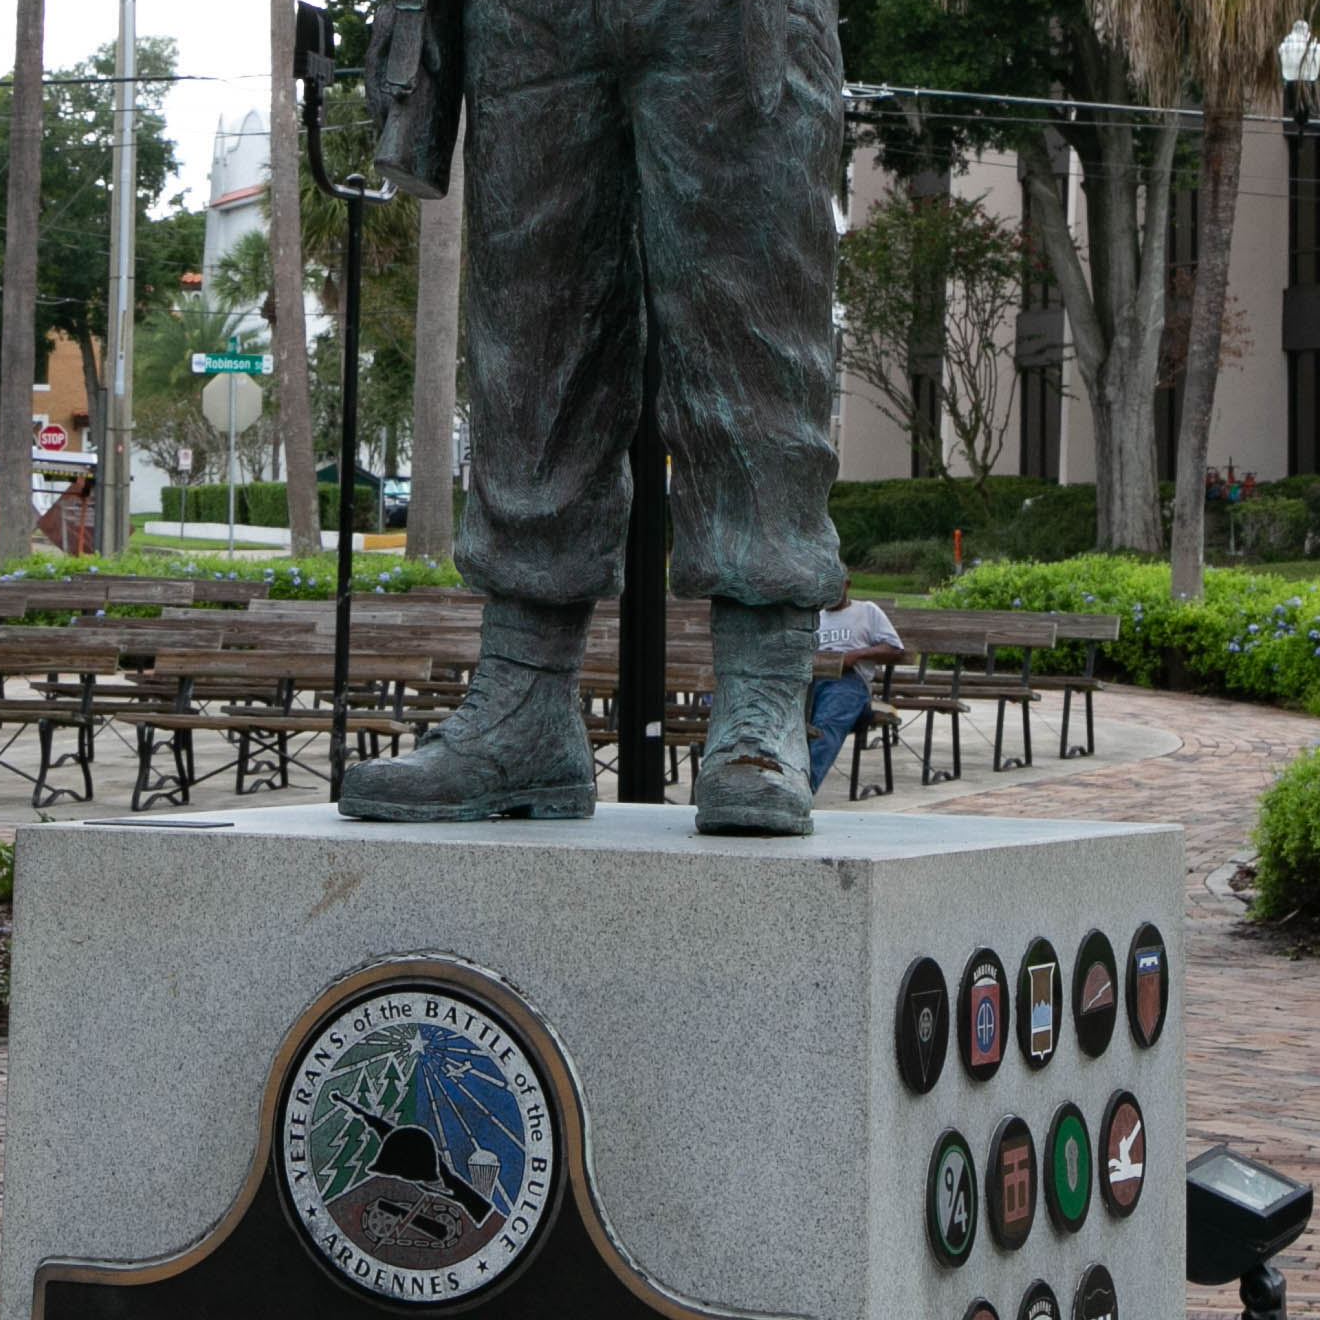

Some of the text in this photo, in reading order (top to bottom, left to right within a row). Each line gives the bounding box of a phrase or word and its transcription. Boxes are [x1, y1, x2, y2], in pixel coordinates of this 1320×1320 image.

[205, 358, 251, 369] Robinson
[40, 433, 65, 445] STOP
[973, 963, 998, 982] AIRBORNE
[354, 1008, 373, 1032] of
[380, 1001, 413, 1020] the
[425, 1000, 516, 1066] BATTLE
[514, 1072, 537, 1096] of
[526, 1103, 546, 1142] the
[499, 1156, 548, 1254] BULGE
[321, 1232, 460, 1296] ARDENNES
